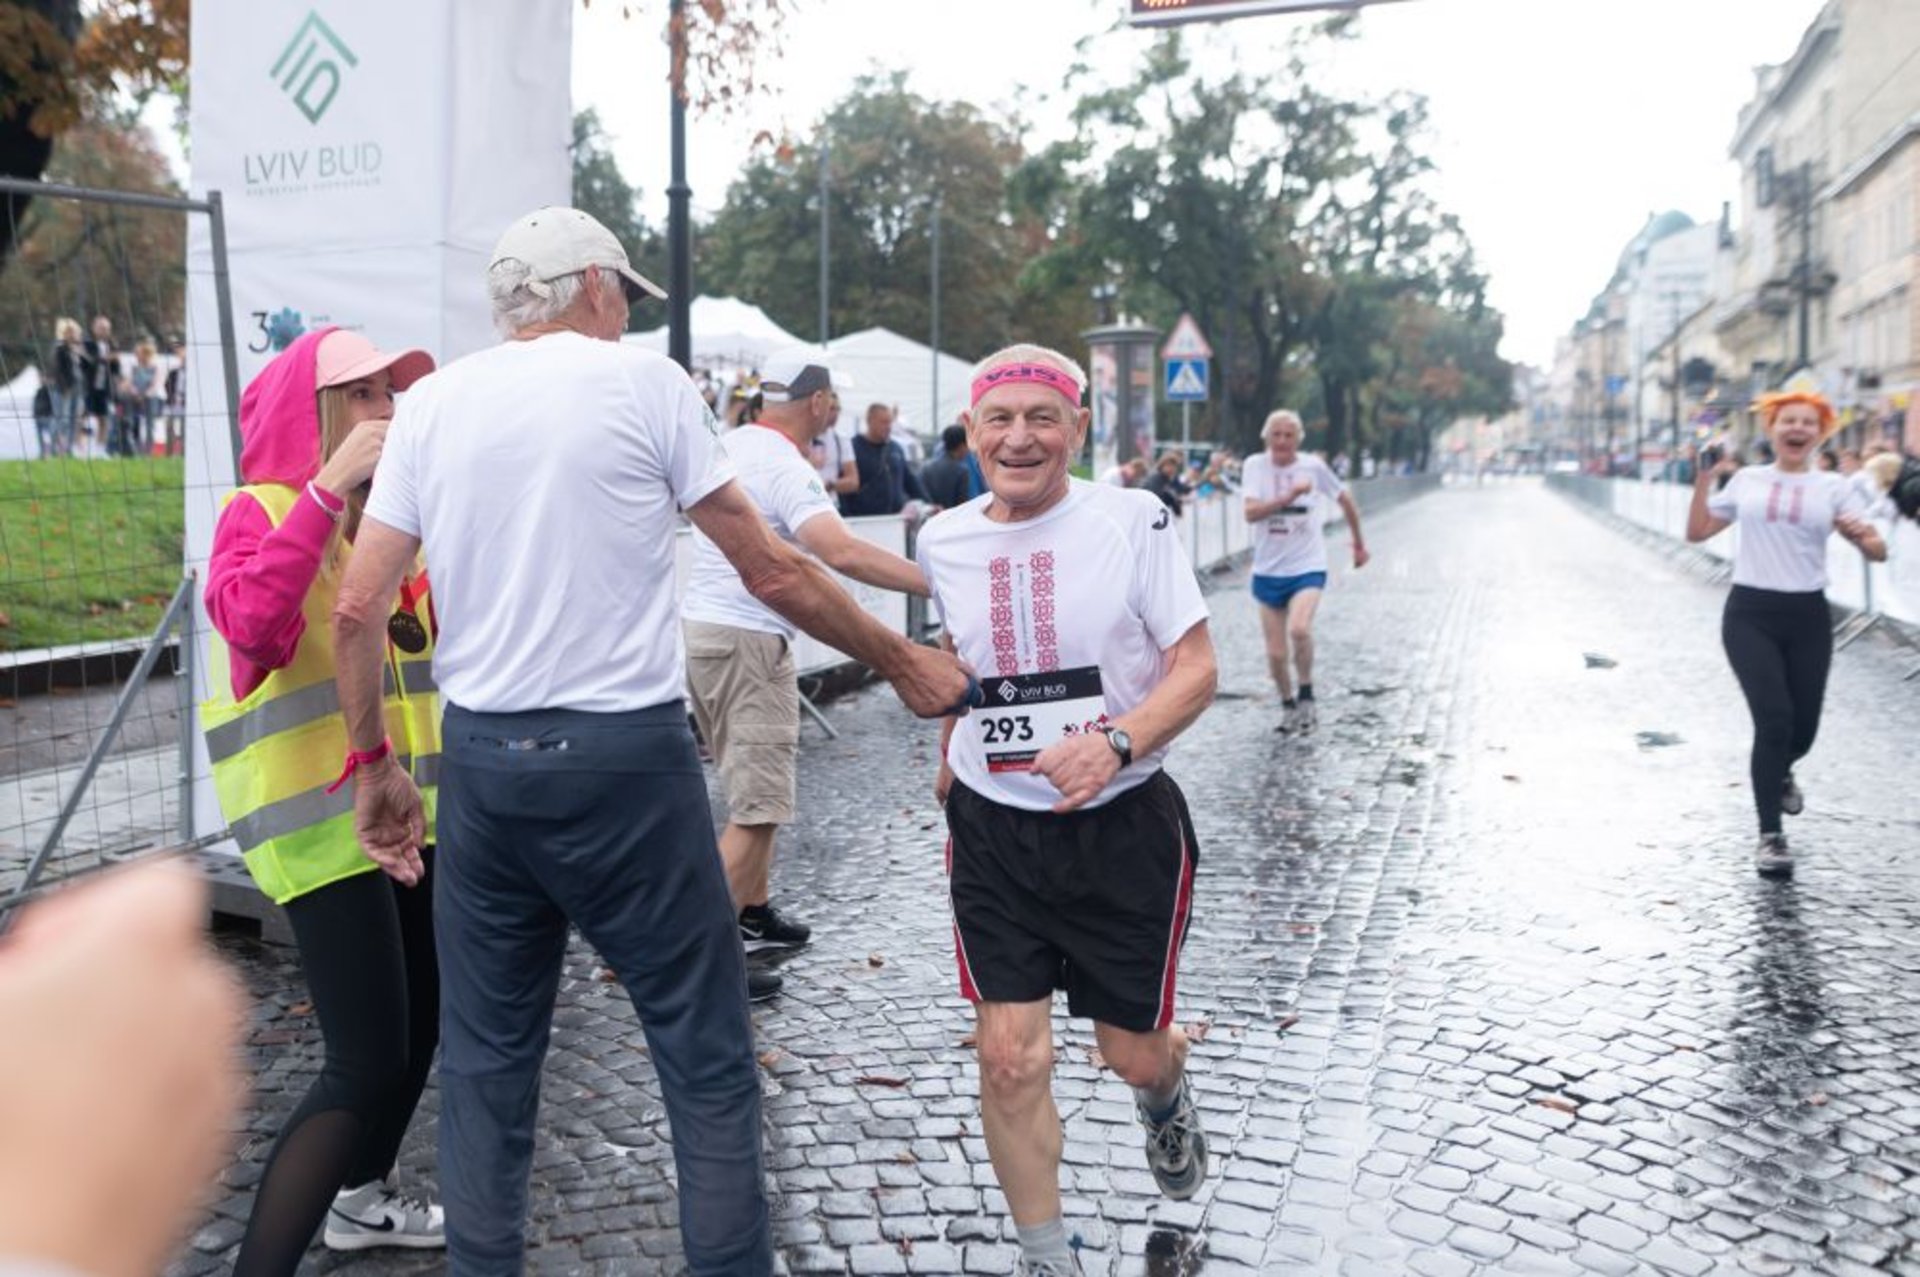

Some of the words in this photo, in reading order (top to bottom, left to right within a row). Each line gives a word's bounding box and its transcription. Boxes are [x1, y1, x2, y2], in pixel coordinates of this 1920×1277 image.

[244, 151, 308, 185] LVIV
[318, 142, 382, 178] BUD
[1020, 686, 1042, 698] LVIV
[1044, 683, 1067, 696] BUD
[981, 716, 1034, 743] 293
